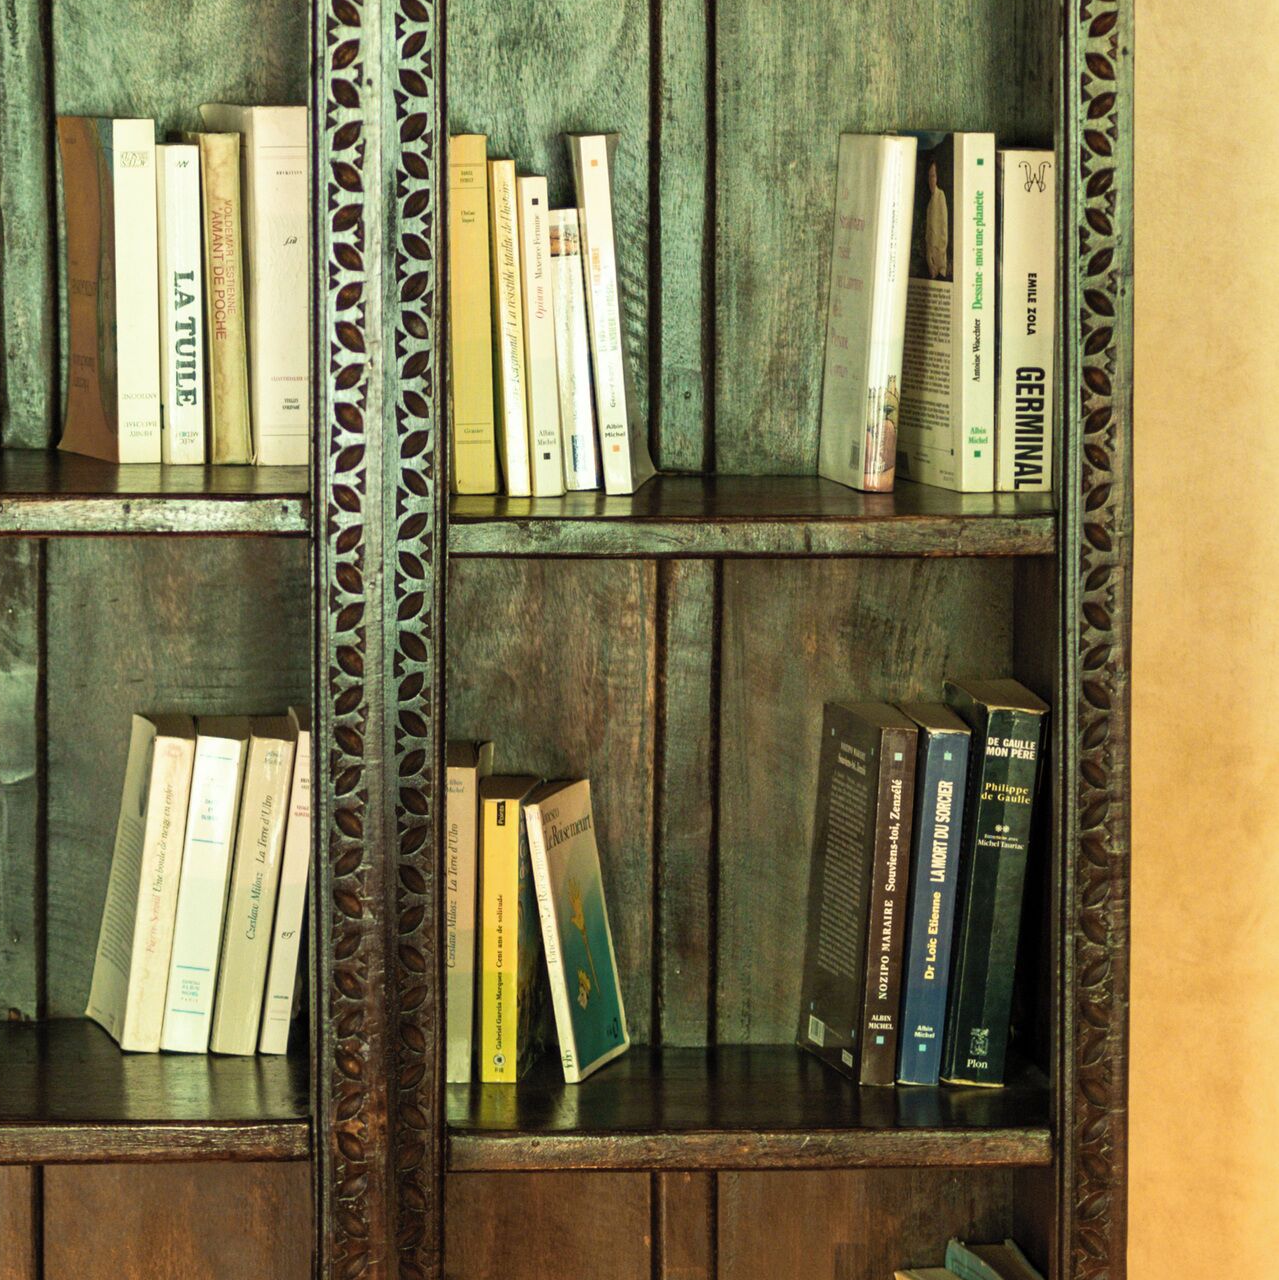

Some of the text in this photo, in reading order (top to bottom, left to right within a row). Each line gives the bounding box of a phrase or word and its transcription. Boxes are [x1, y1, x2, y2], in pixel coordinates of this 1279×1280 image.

[222, 199, 234, 256] VOLDEMAR
[210, 206, 228, 342] 'AMANT DE POCHE
[533, 215, 548, 320] Opium Maxence Fermine
[1027, 273, 1037, 336] EMILE ZOLA
[174, 271, 197, 407] LA TUILE
[971, 318, 982, 382] Antoine Waechter
[604, 431, 626, 439] Michel
[968, 426, 989, 444] Albin Michel
[1013, 366, 1046, 490] GERMINAL
[986, 747, 1036, 761] MON PÈRE
[987, 737, 1036, 750] DE GAULLE
[166, 784, 176, 806] enfer
[981, 792, 1032, 805] de Gaulle
[984, 782, 1030, 797] Philippe
[162, 817, 173, 840] neige
[256, 795, 273, 864] La Terre d'Ulro
[885, 779, 903, 892] Souviens-toi, Zenzélé
[930, 780, 954, 883] LA MORT DU SORCIER
[447, 823, 459, 892] La Terre d'Ulro
[977, 839, 1026, 850] Michel Tauriac
[157, 849, 168, 874] boule
[152, 873, 164, 893] Une
[246, 872, 264, 941] Czeslaw Milosz
[495, 894, 503, 923] solitude
[446, 900, 457, 968] Czeslaw Milosz
[495, 924, 503, 935] de
[924, 891, 942, 980] Dr Loïc Etienne
[495, 952, 503, 968] Cent
[878, 900, 894, 1000] NOZIPO MARAIRE
[868, 1022, 894, 1030] MICHEL
[871, 1014, 892, 1022] ALBIN
[966, 1058, 989, 1069] Plon
